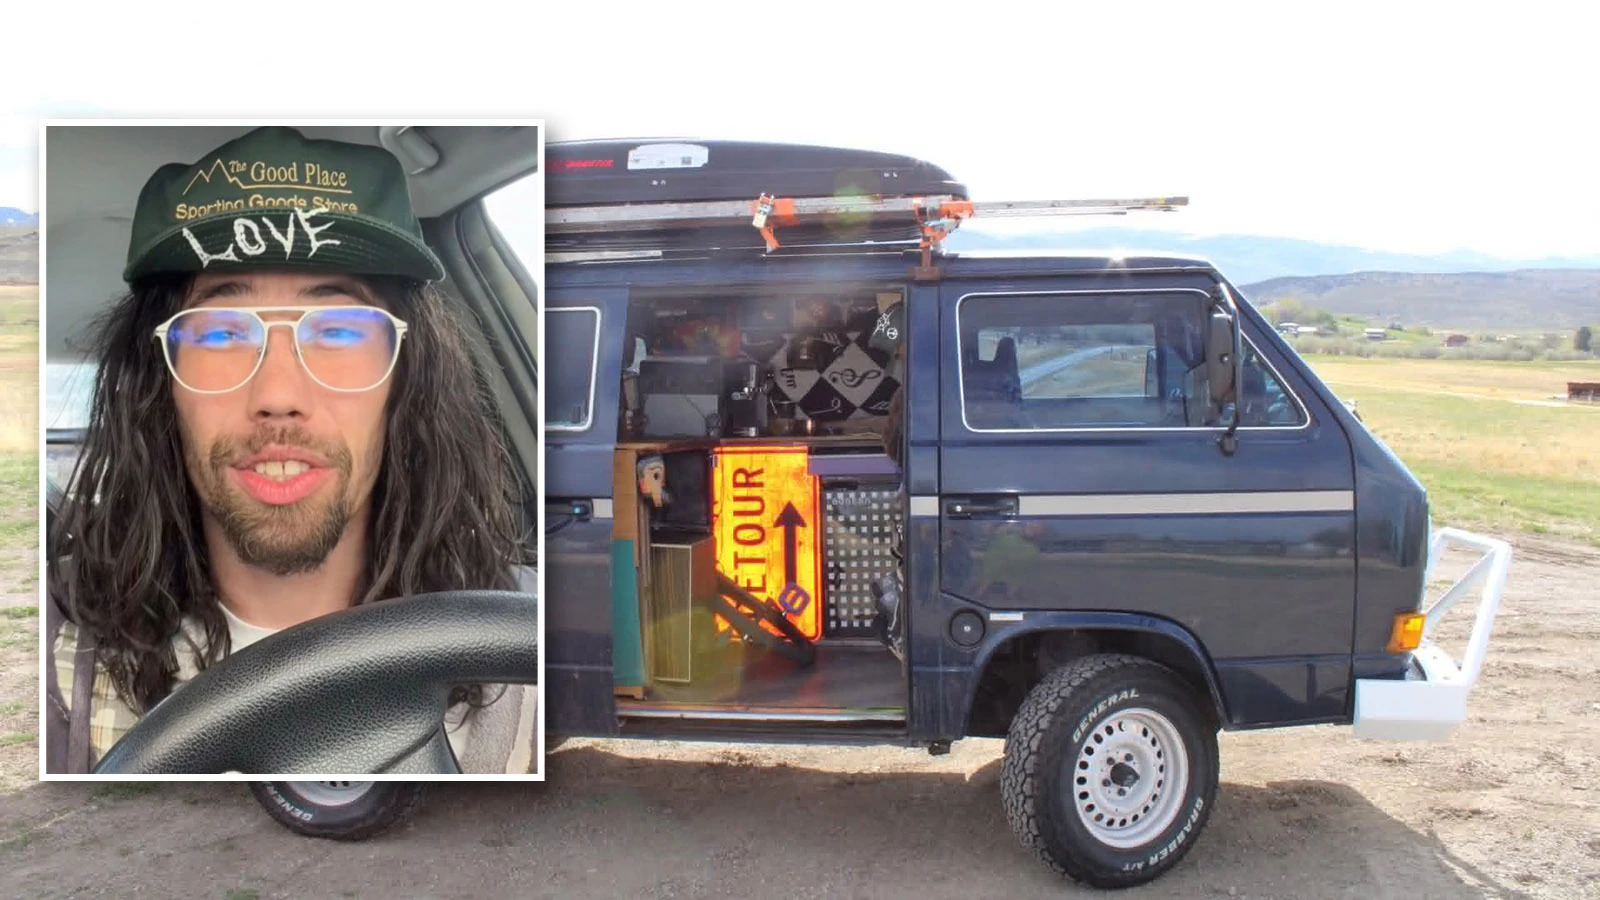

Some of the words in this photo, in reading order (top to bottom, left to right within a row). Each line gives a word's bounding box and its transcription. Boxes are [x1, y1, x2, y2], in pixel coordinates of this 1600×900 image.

[229, 159, 247, 173] The
[250, 161, 298, 184] Good
[304, 163, 347, 187] Place
[182, 206, 341, 268] LOVE
[733, 467, 767, 594] ETOUR
[1073, 688, 1140, 743] GENERAL
[1149, 797, 1204, 864] GRABBER
